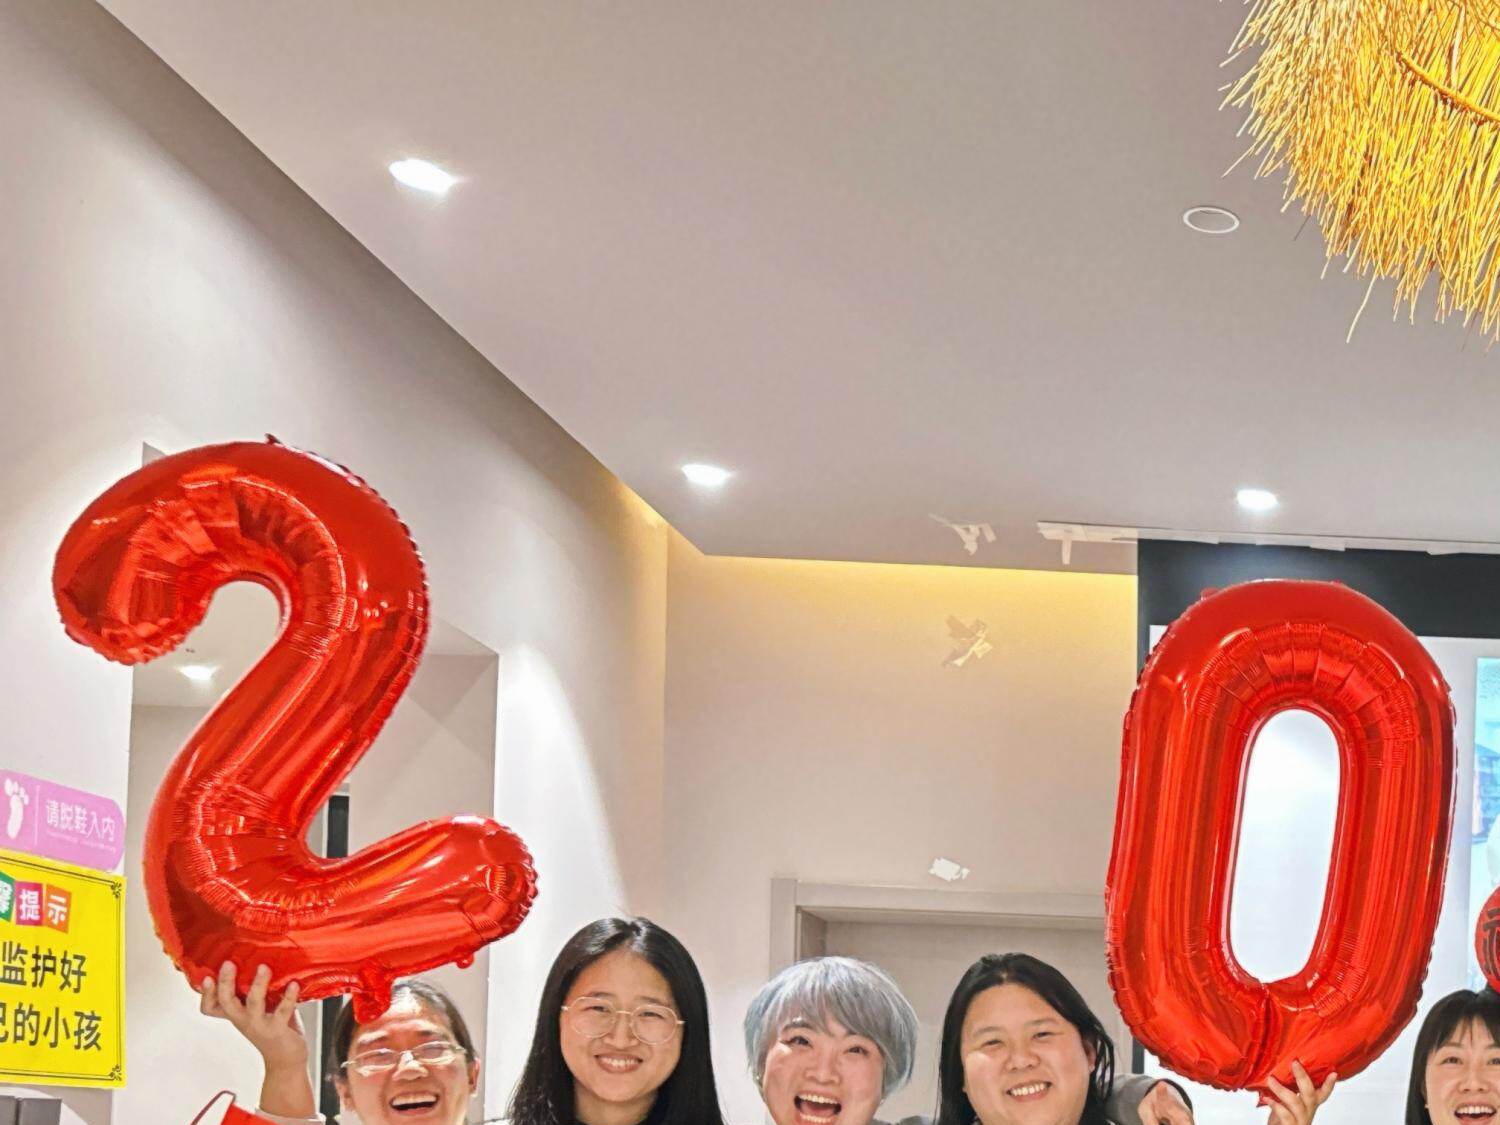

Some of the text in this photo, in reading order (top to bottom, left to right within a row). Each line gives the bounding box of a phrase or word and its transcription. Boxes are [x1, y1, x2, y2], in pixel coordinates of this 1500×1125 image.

[46, 799, 116, 842] 请脱鞋入内
[0, 940, 87, 994] 监护好
